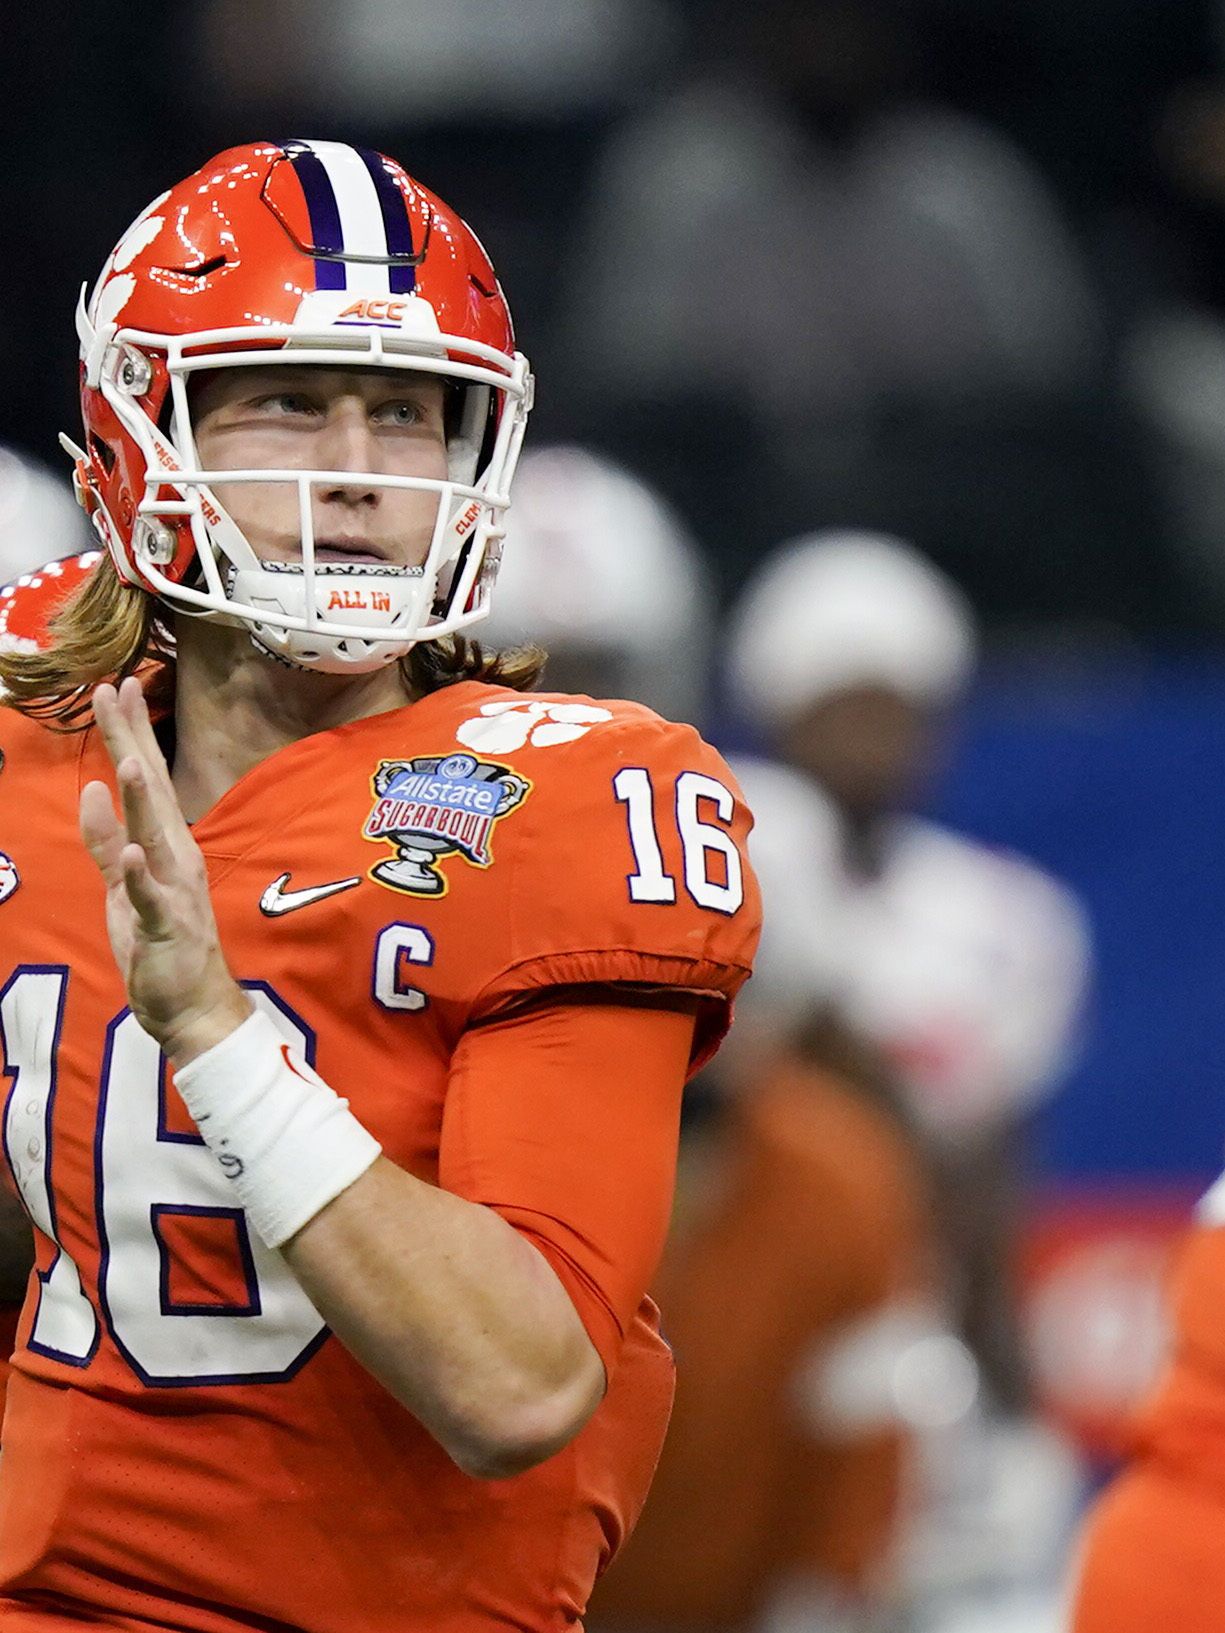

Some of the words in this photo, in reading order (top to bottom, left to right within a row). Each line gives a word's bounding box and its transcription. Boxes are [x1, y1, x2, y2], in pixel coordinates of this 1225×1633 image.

[338, 299, 408, 321] ACC
[327, 590, 367, 610] ALL
[370, 591, 391, 613] IN
[389, 775, 494, 811] Allstate
[612, 767, 745, 918] 16
[371, 920, 436, 1013] C
